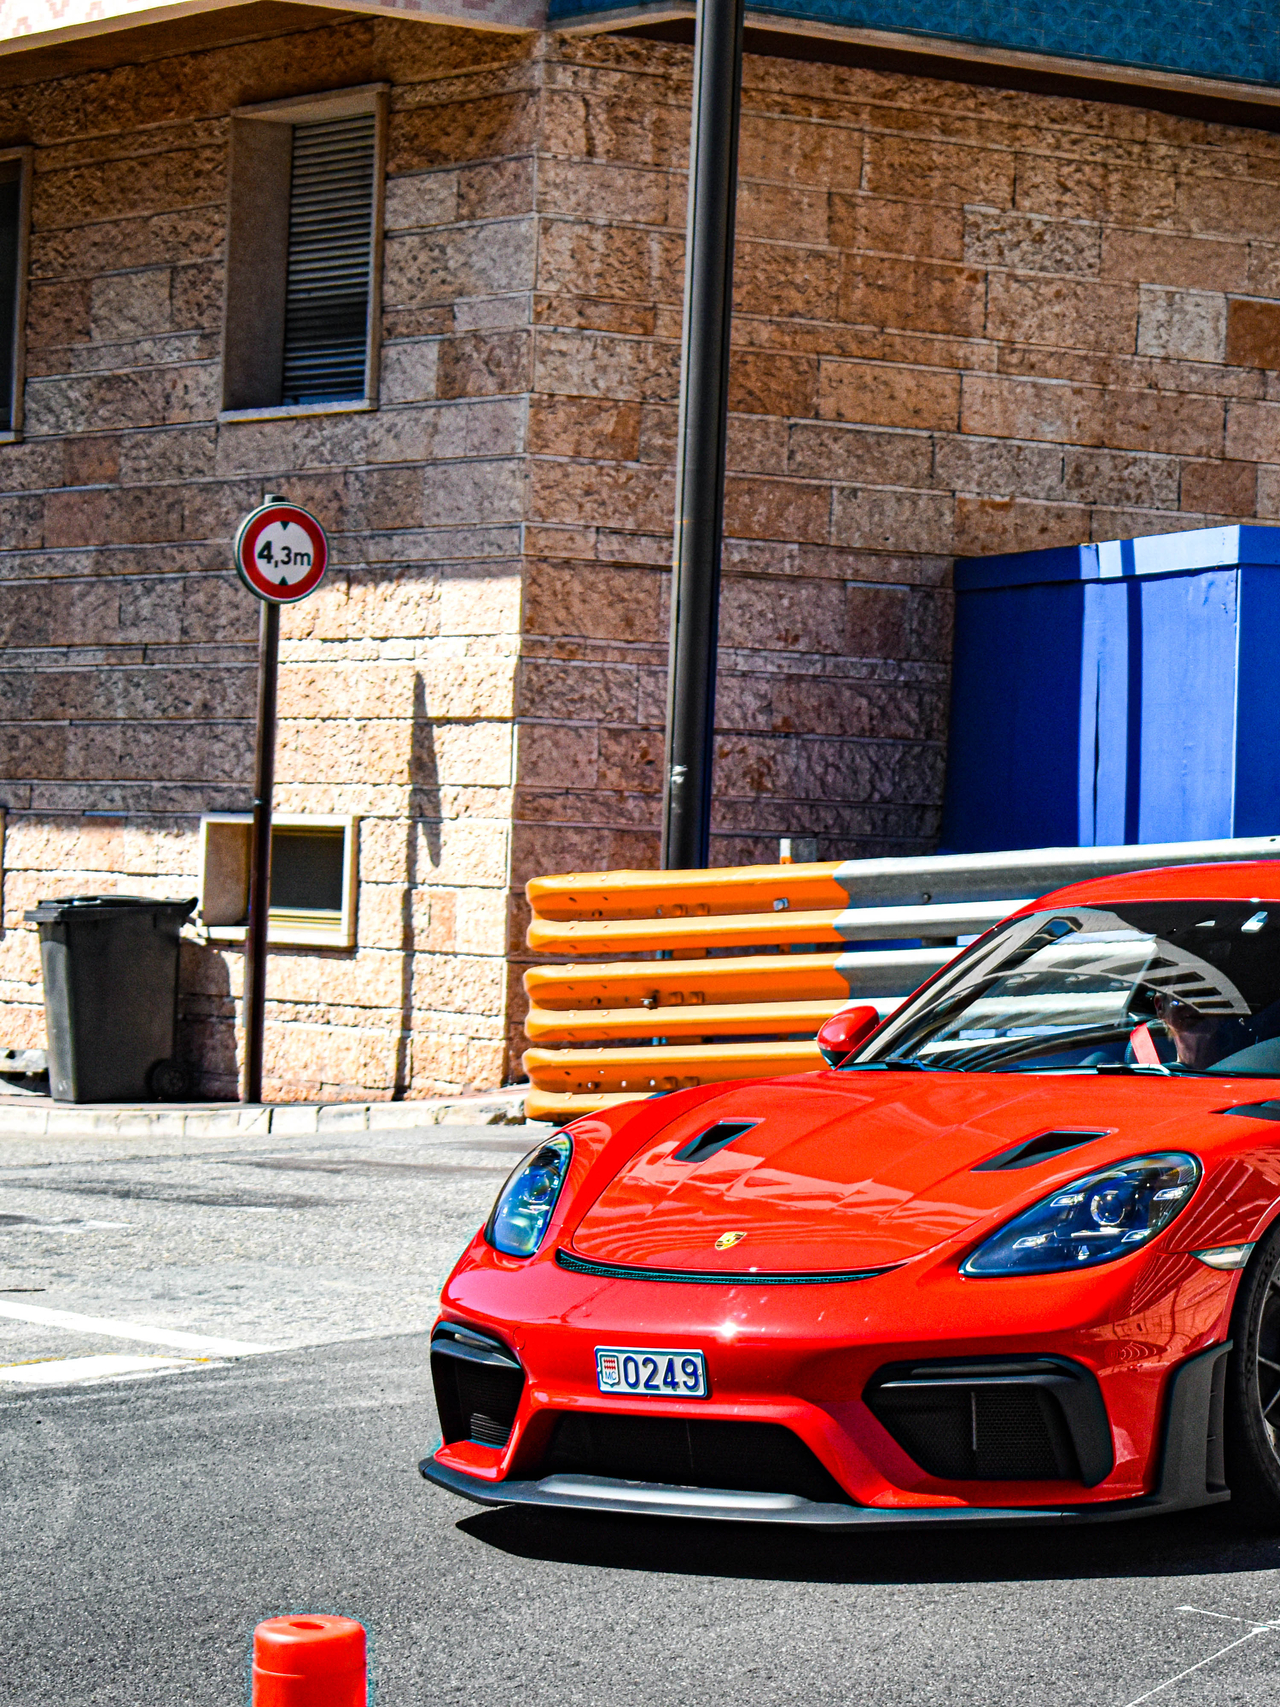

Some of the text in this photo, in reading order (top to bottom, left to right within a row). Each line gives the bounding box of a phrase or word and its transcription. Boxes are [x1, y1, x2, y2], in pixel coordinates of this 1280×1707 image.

[257, 540, 312, 568] 4,3m
[604, 1354, 700, 1391] MC 0249
